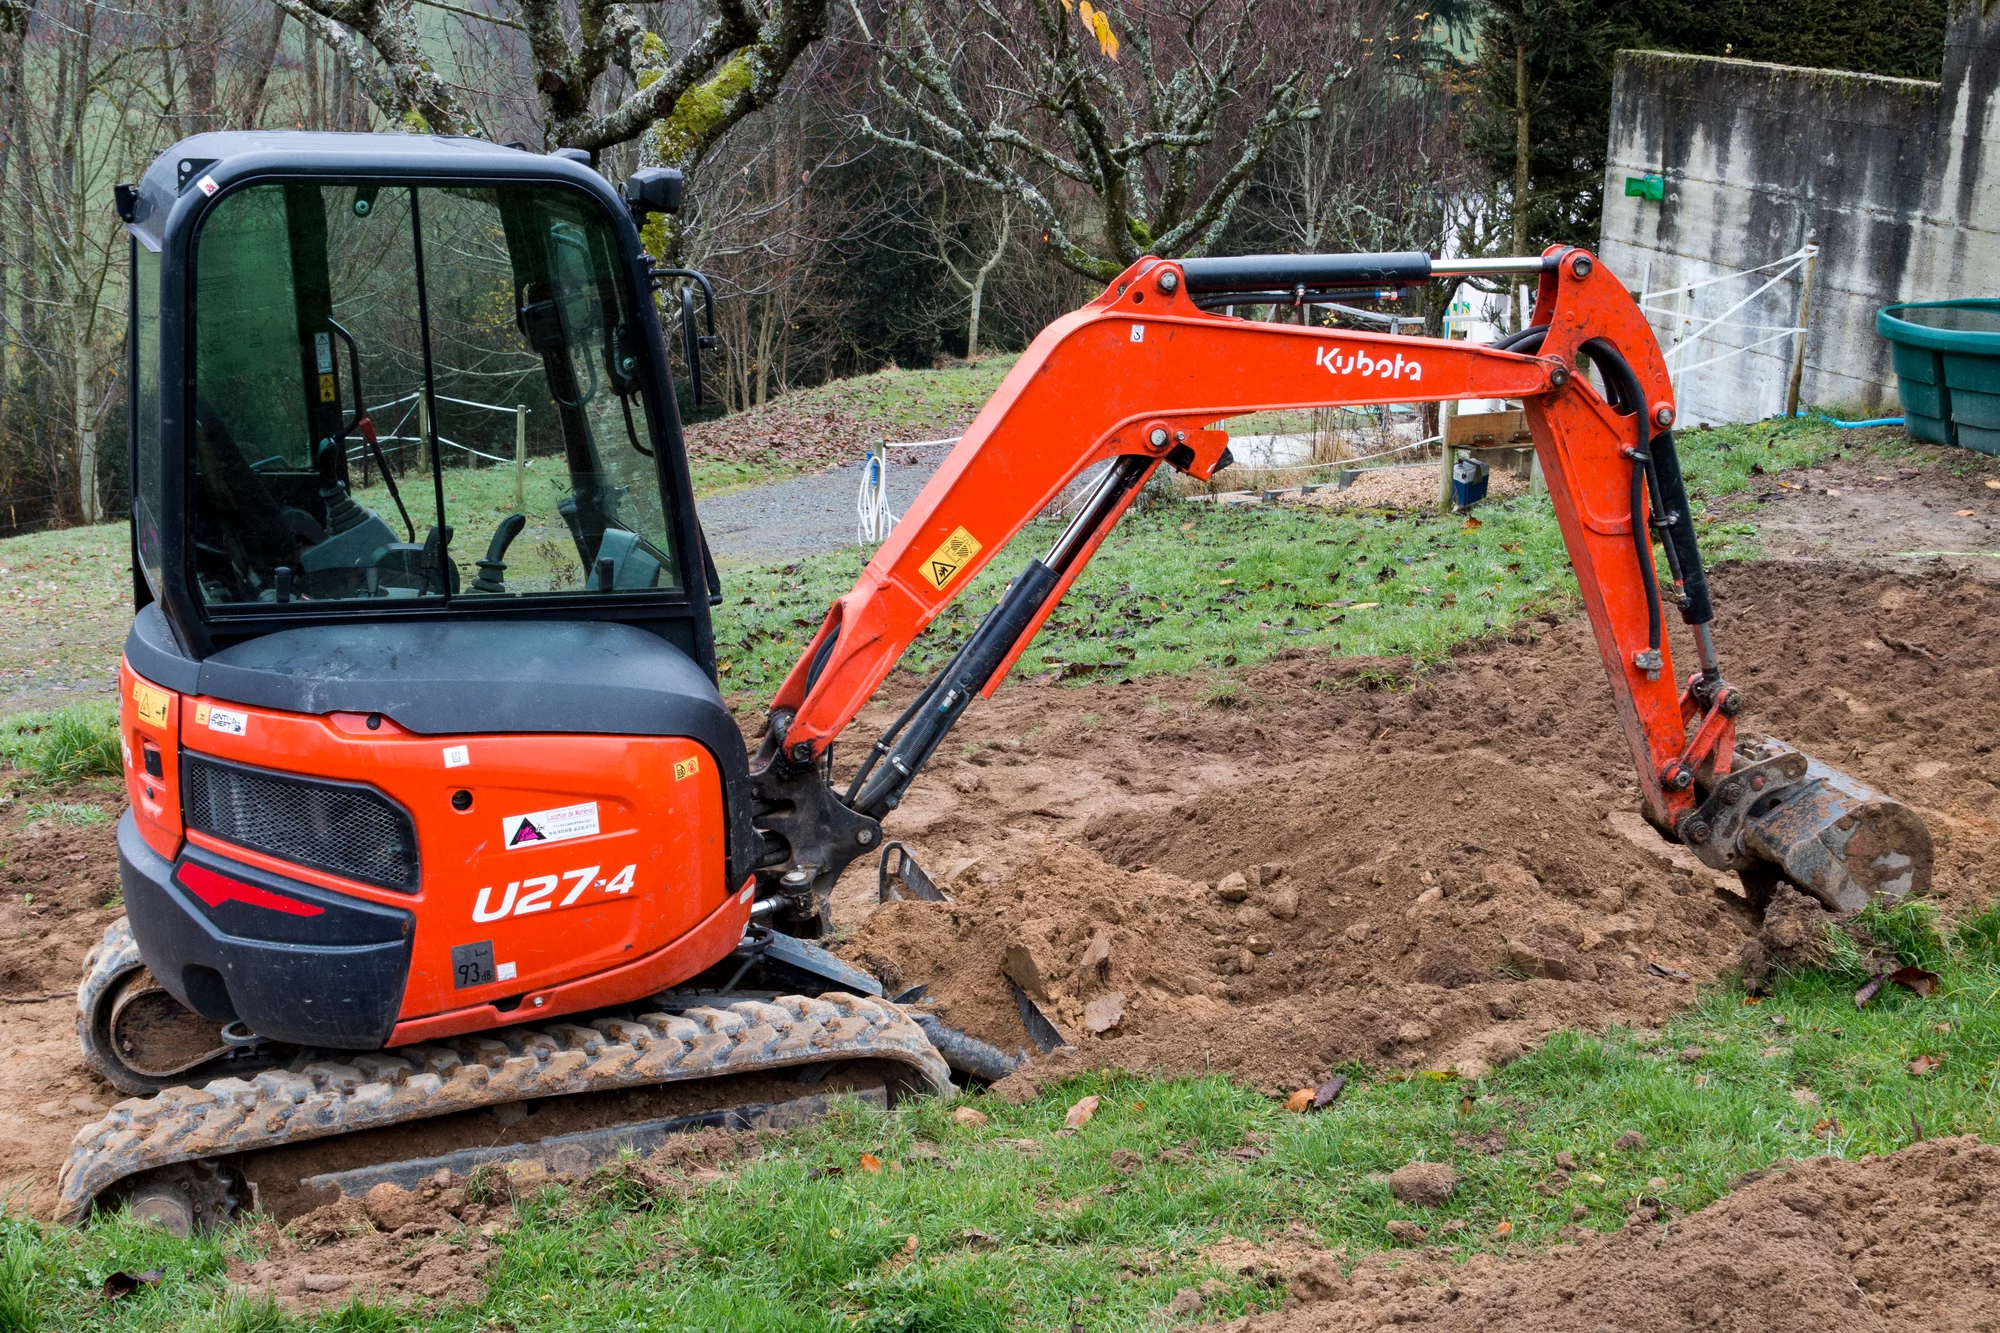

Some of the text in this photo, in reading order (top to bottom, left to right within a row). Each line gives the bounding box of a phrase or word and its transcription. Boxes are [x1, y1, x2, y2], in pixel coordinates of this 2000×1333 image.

[1316, 346, 1422, 381] Kubota
[211, 719, 231, 728] THEFT
[568, 810, 574, 818] de
[472, 864, 637, 923] U27-4
[458, 962, 480, 985] 93
[481, 969, 492, 981] dB
